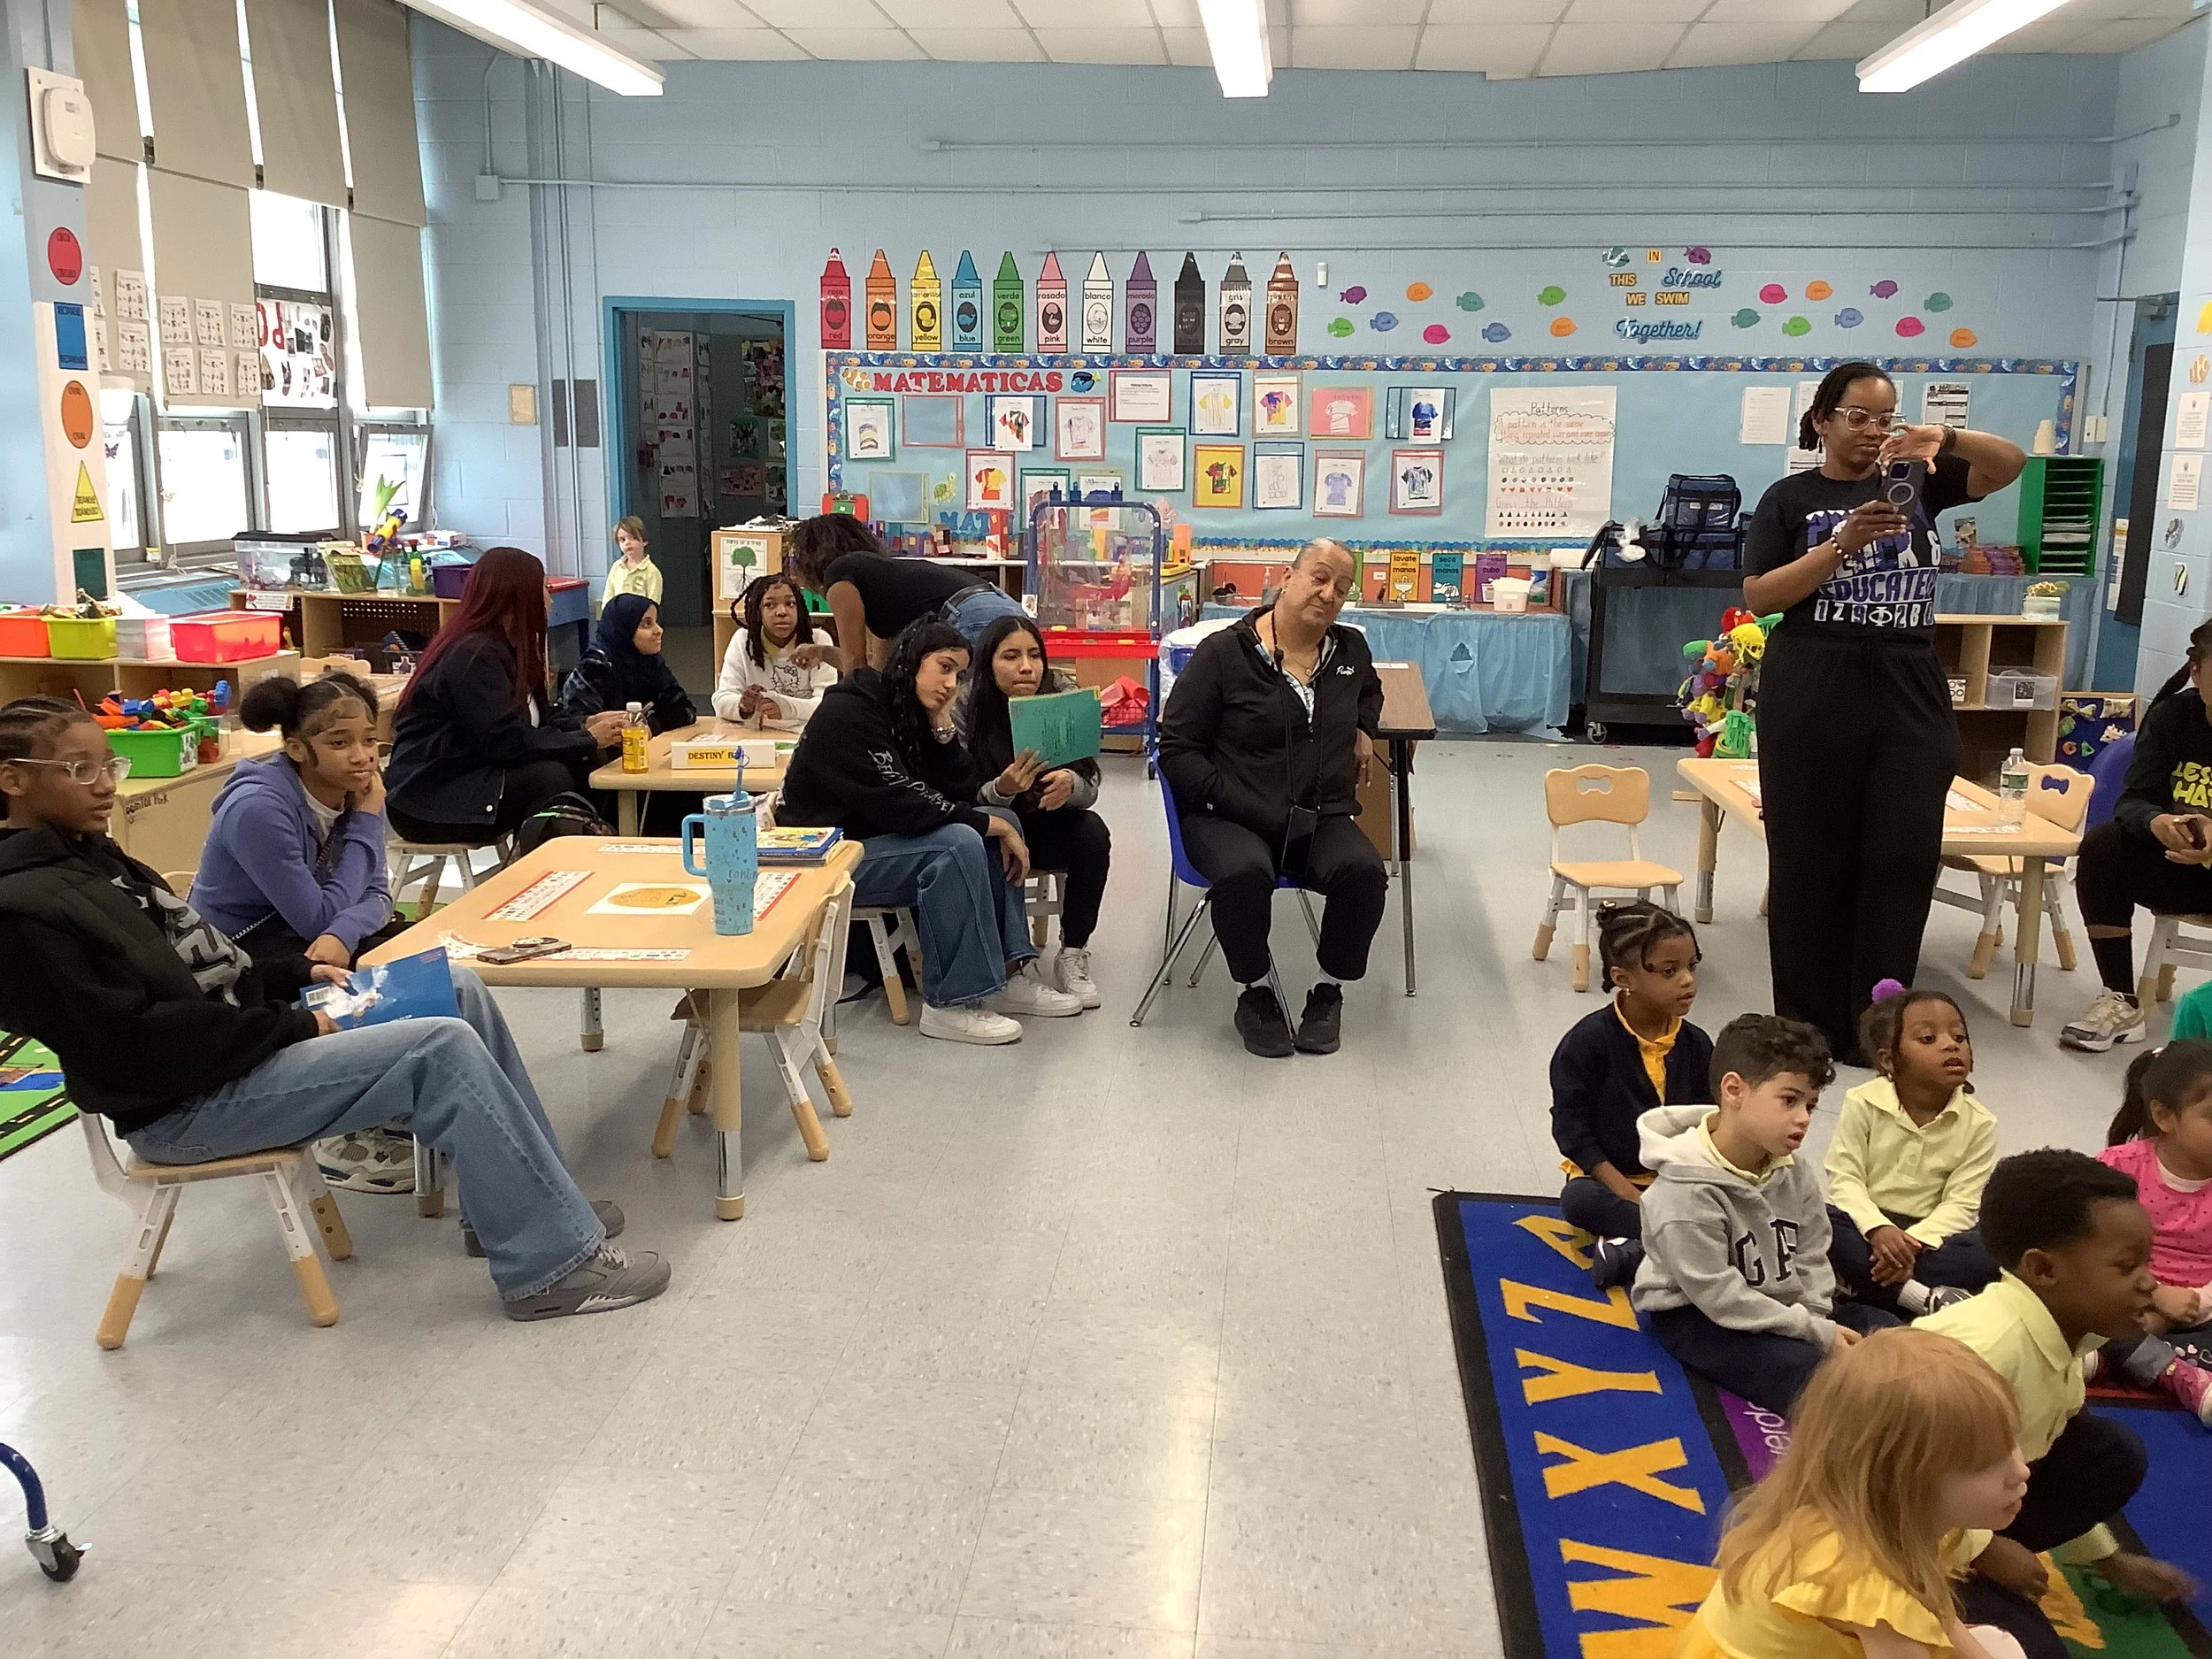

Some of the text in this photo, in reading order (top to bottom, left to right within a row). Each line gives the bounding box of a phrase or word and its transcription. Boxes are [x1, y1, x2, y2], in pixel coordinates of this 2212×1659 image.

[1648, 250, 1660, 261] IN
[1610, 267, 1722, 288] THIS School
[1626, 292, 1689, 305] WE SWIM
[1616, 319, 1702, 343] Together!
[868, 334, 895, 342] orange
[959, 334, 976, 342] blue
[997, 335, 1020, 344] green
[1044, 335, 1060, 344] pink
[1128, 336, 1154, 345] purple
[873, 372, 1063, 393] MATEMATICAS
[1531, 402, 1569, 413] Patterns
[1500, 1277, 1641, 1332] Z
[1514, 1348, 1663, 1406] Y
[1533, 1430, 1706, 1515] X
